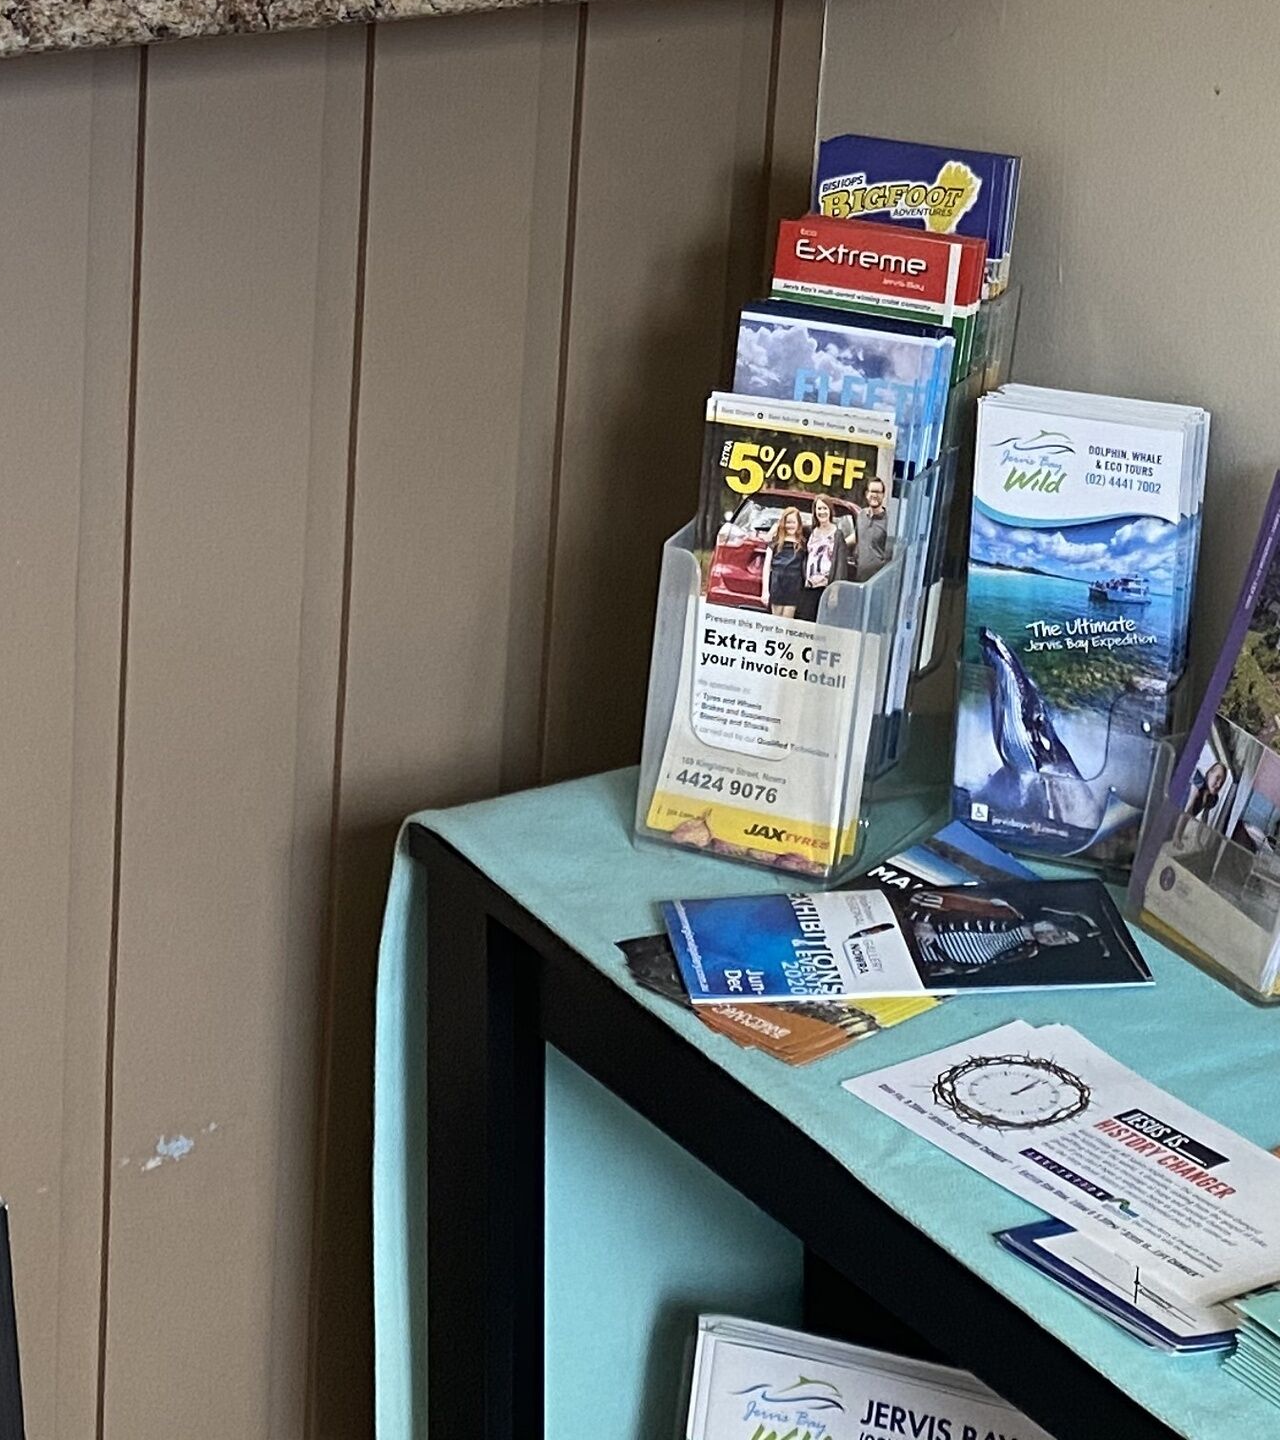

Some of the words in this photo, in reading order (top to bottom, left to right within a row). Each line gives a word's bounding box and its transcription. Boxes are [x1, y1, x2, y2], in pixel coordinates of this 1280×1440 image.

[821, 184, 965, 218] BIGFOOT
[796, 239, 927, 275] Extreme
[1095, 460, 1102, 470] &
[1104, 463, 1122, 473] ECO
[1124, 465, 1153, 477] TOURS
[1132, 452, 1162, 464] WHALE
[1003, 466, 1067, 494] Wild
[1085, 473, 1106, 486] (02)
[1110, 478, 1134, 489] 4441
[1138, 480, 1161, 494] 7002
[1025, 621, 1061, 638] The
[1066, 617, 1136, 636] Ultimate
[704, 628, 757, 653] Extra
[765, 640, 794, 661] 5%
[802, 646, 842, 669] OFF
[1023, 639, 1063, 652] Jervis
[1067, 638, 1089, 653] Bay
[1092, 635, 1157, 648] Expedition
[701, 651, 737, 670] your
[741, 656, 799, 680] invoice
[676, 769, 726, 795] 4424
[730, 779, 778, 805] 9076
[1120, 1112, 1170, 1141] JESUS
[1168, 1136, 1188, 1149] IS
[1092, 1119, 1161, 1158] HISTORY
[1156, 1155, 1236, 1200] CHANGER
